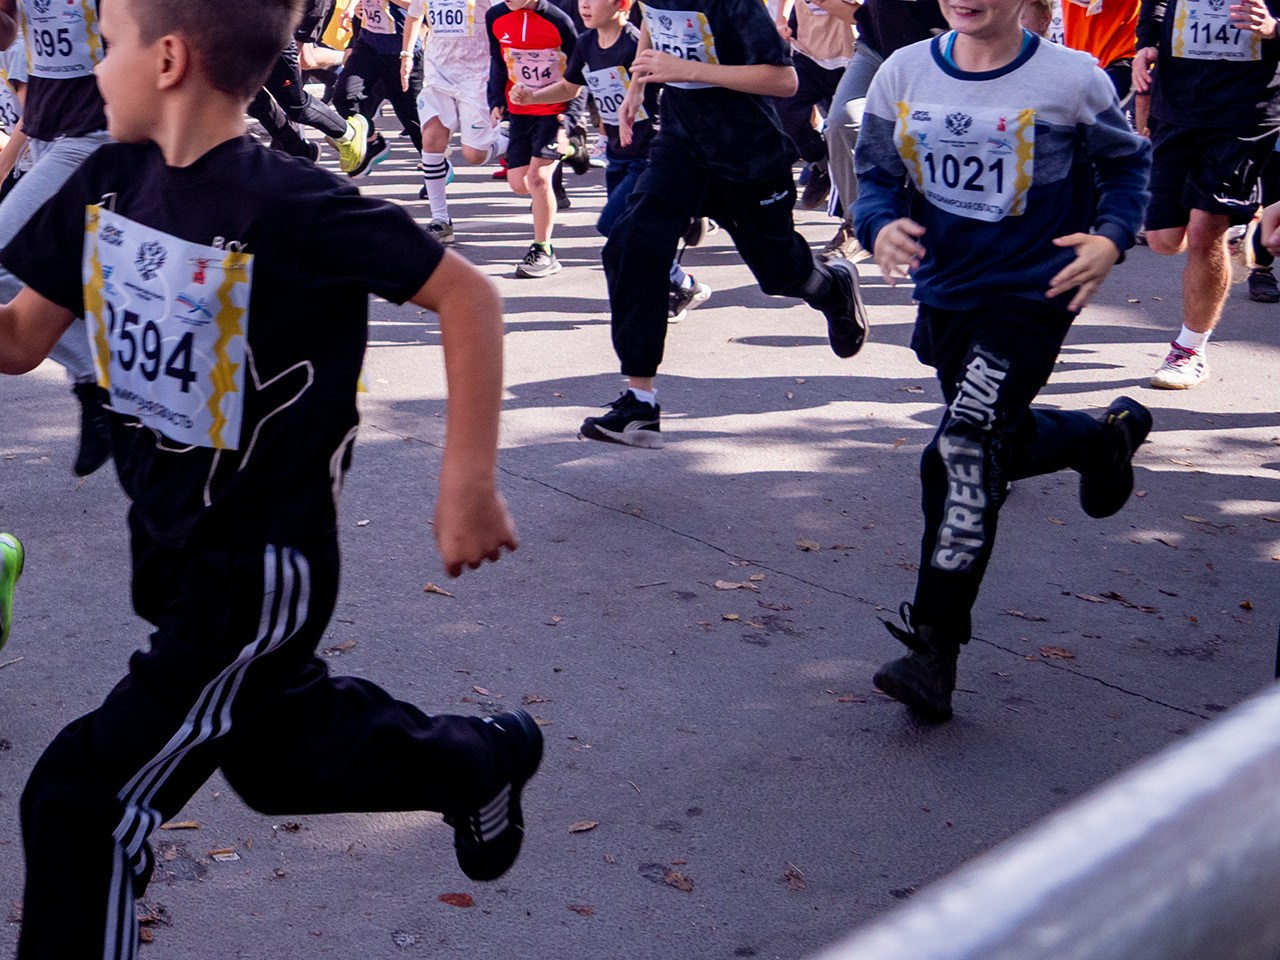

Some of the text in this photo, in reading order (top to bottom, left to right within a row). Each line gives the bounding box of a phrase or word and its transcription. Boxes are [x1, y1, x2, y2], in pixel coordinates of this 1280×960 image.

[429, 9, 463, 26] 3160
[1190, 21, 1241, 45] 1147
[521, 65, 552, 81] 614
[924, 152, 1004, 194] 1021
[936, 436, 987, 570] STREET
